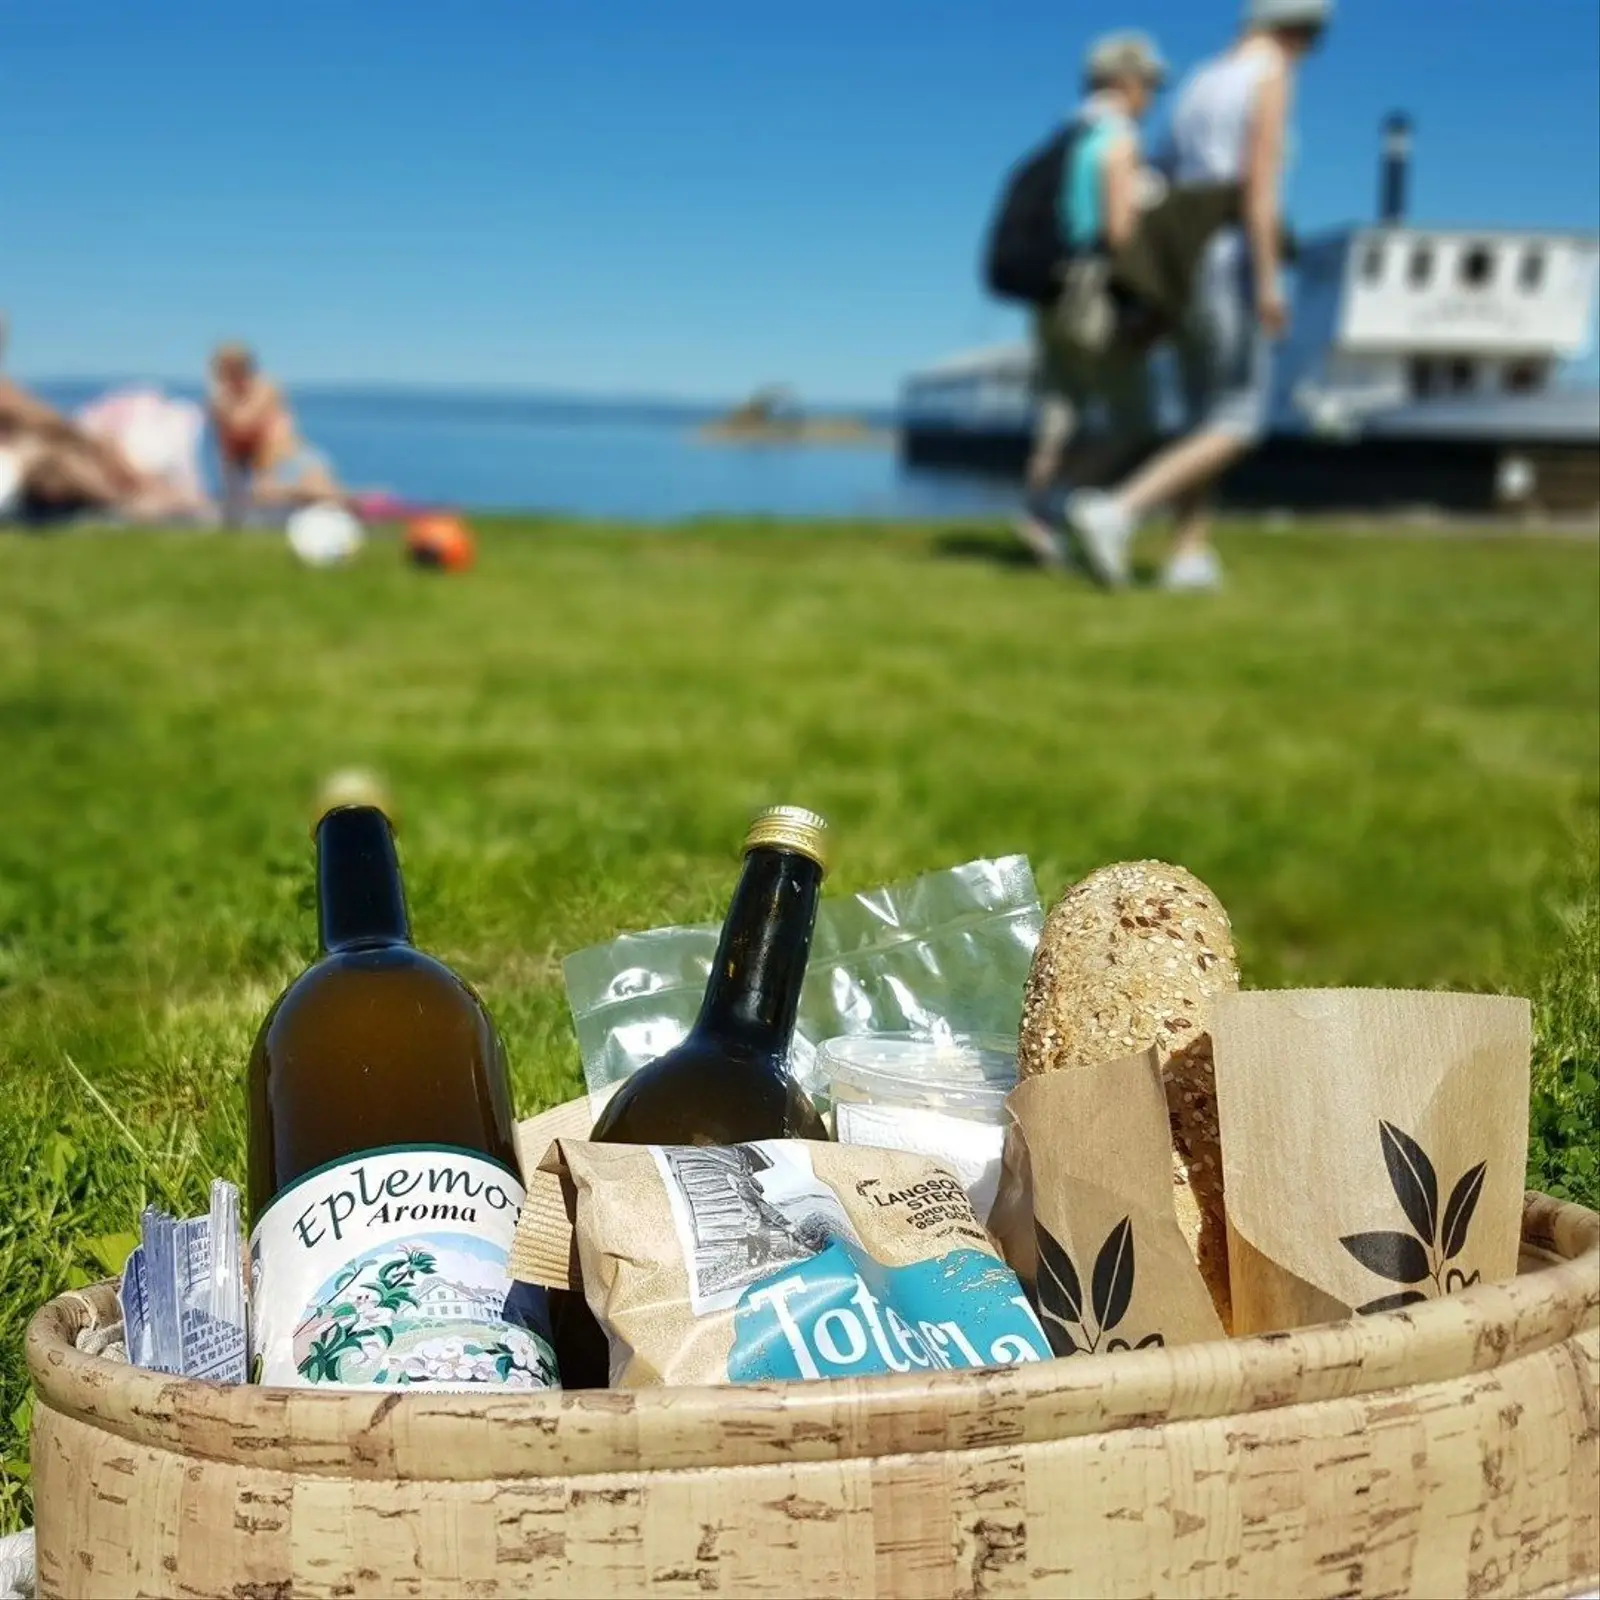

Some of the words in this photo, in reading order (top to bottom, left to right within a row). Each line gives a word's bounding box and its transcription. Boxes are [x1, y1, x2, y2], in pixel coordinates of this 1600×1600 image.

[293, 1166, 521, 1248] Eplemo
[906, 1190, 968, 1210] STEKT
[366, 1202, 477, 1227] Aroma
[905, 1204, 949, 1225] FORDI
